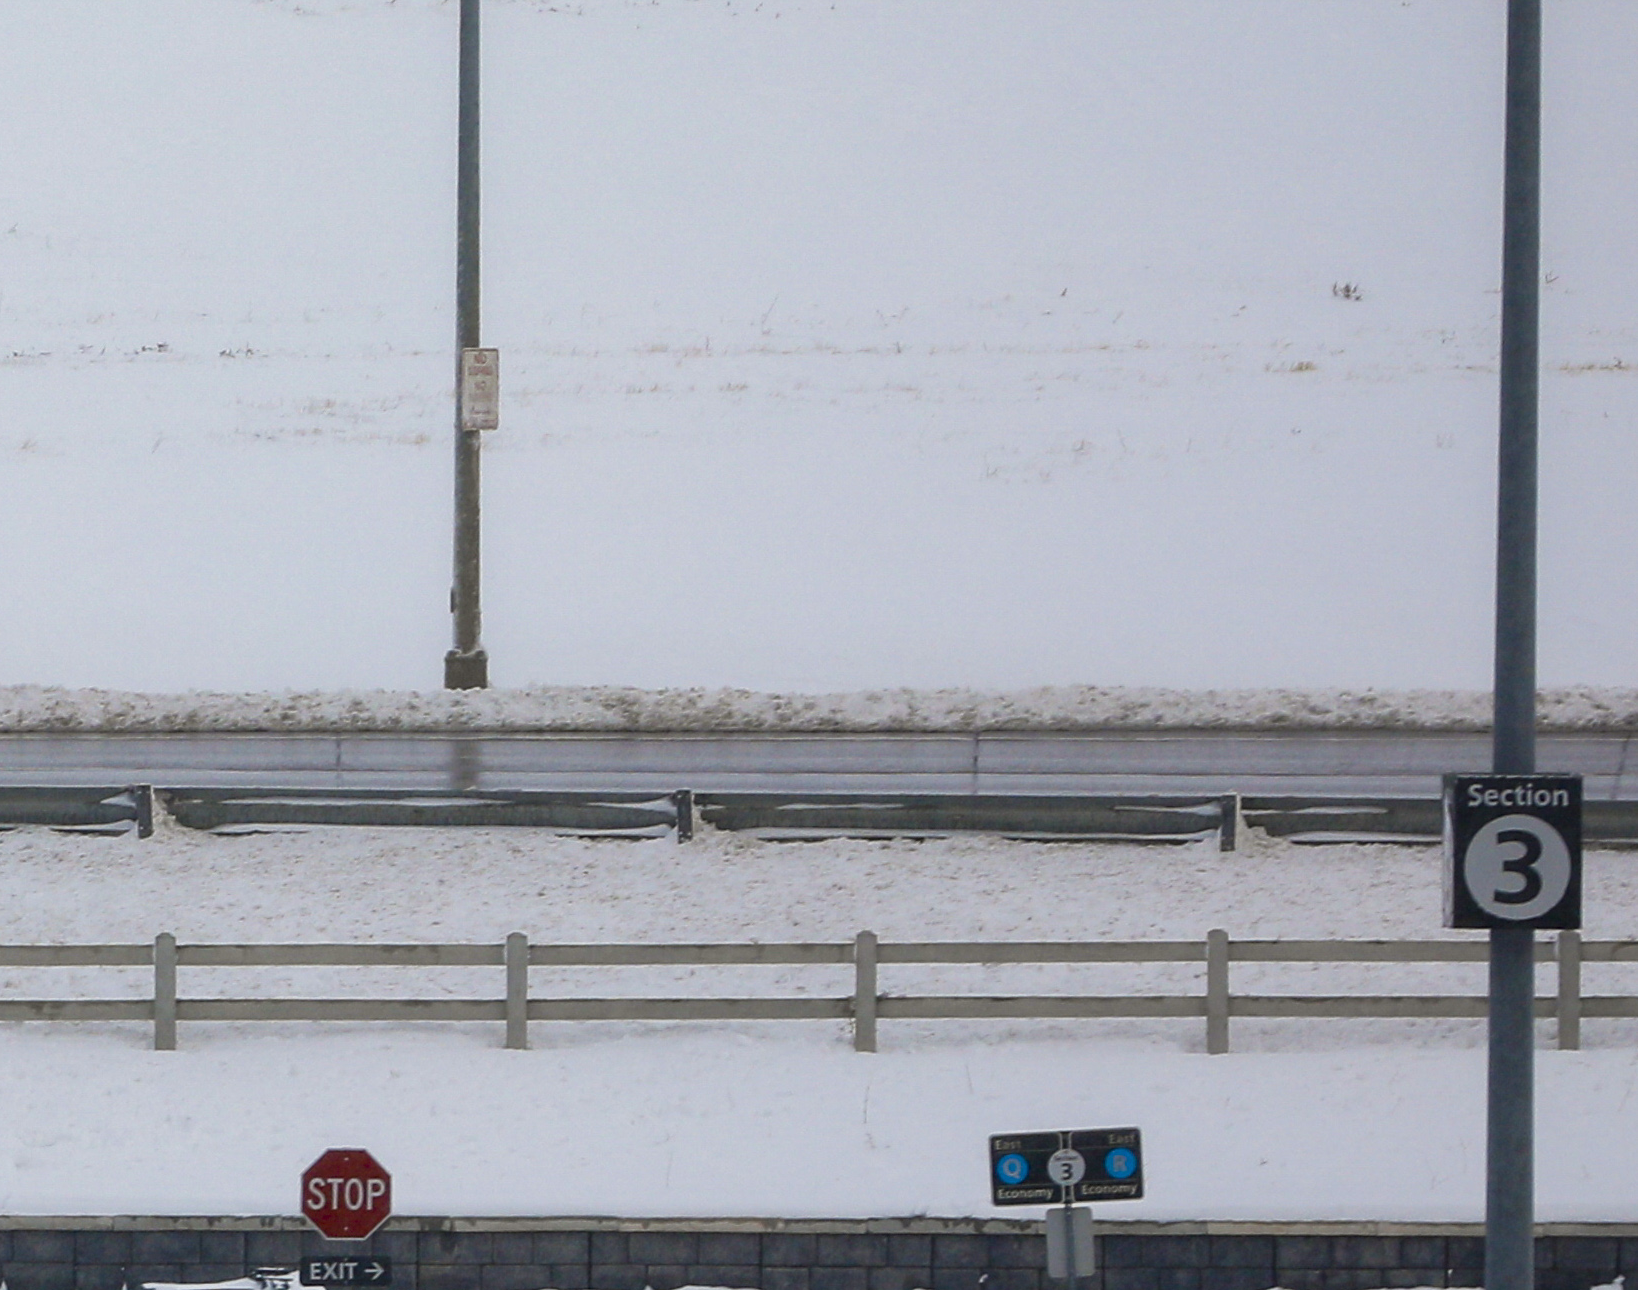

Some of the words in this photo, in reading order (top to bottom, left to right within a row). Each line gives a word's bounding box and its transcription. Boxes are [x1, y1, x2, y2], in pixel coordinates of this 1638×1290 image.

[1468, 783, 1570, 807] Section
[1493, 829, 1544, 905] 3
[996, 1140, 1022, 1150] East
[1109, 1134, 1136, 1145] East
[1003, 1159, 1021, 1178] Q
[1060, 1163, 1073, 1180] 3
[307, 1177, 386, 1211] STOP
[997, 1188, 1054, 1199] Economy
[1083, 1184, 1138, 1195] Economy
[309, 1262, 358, 1281] EXIT
